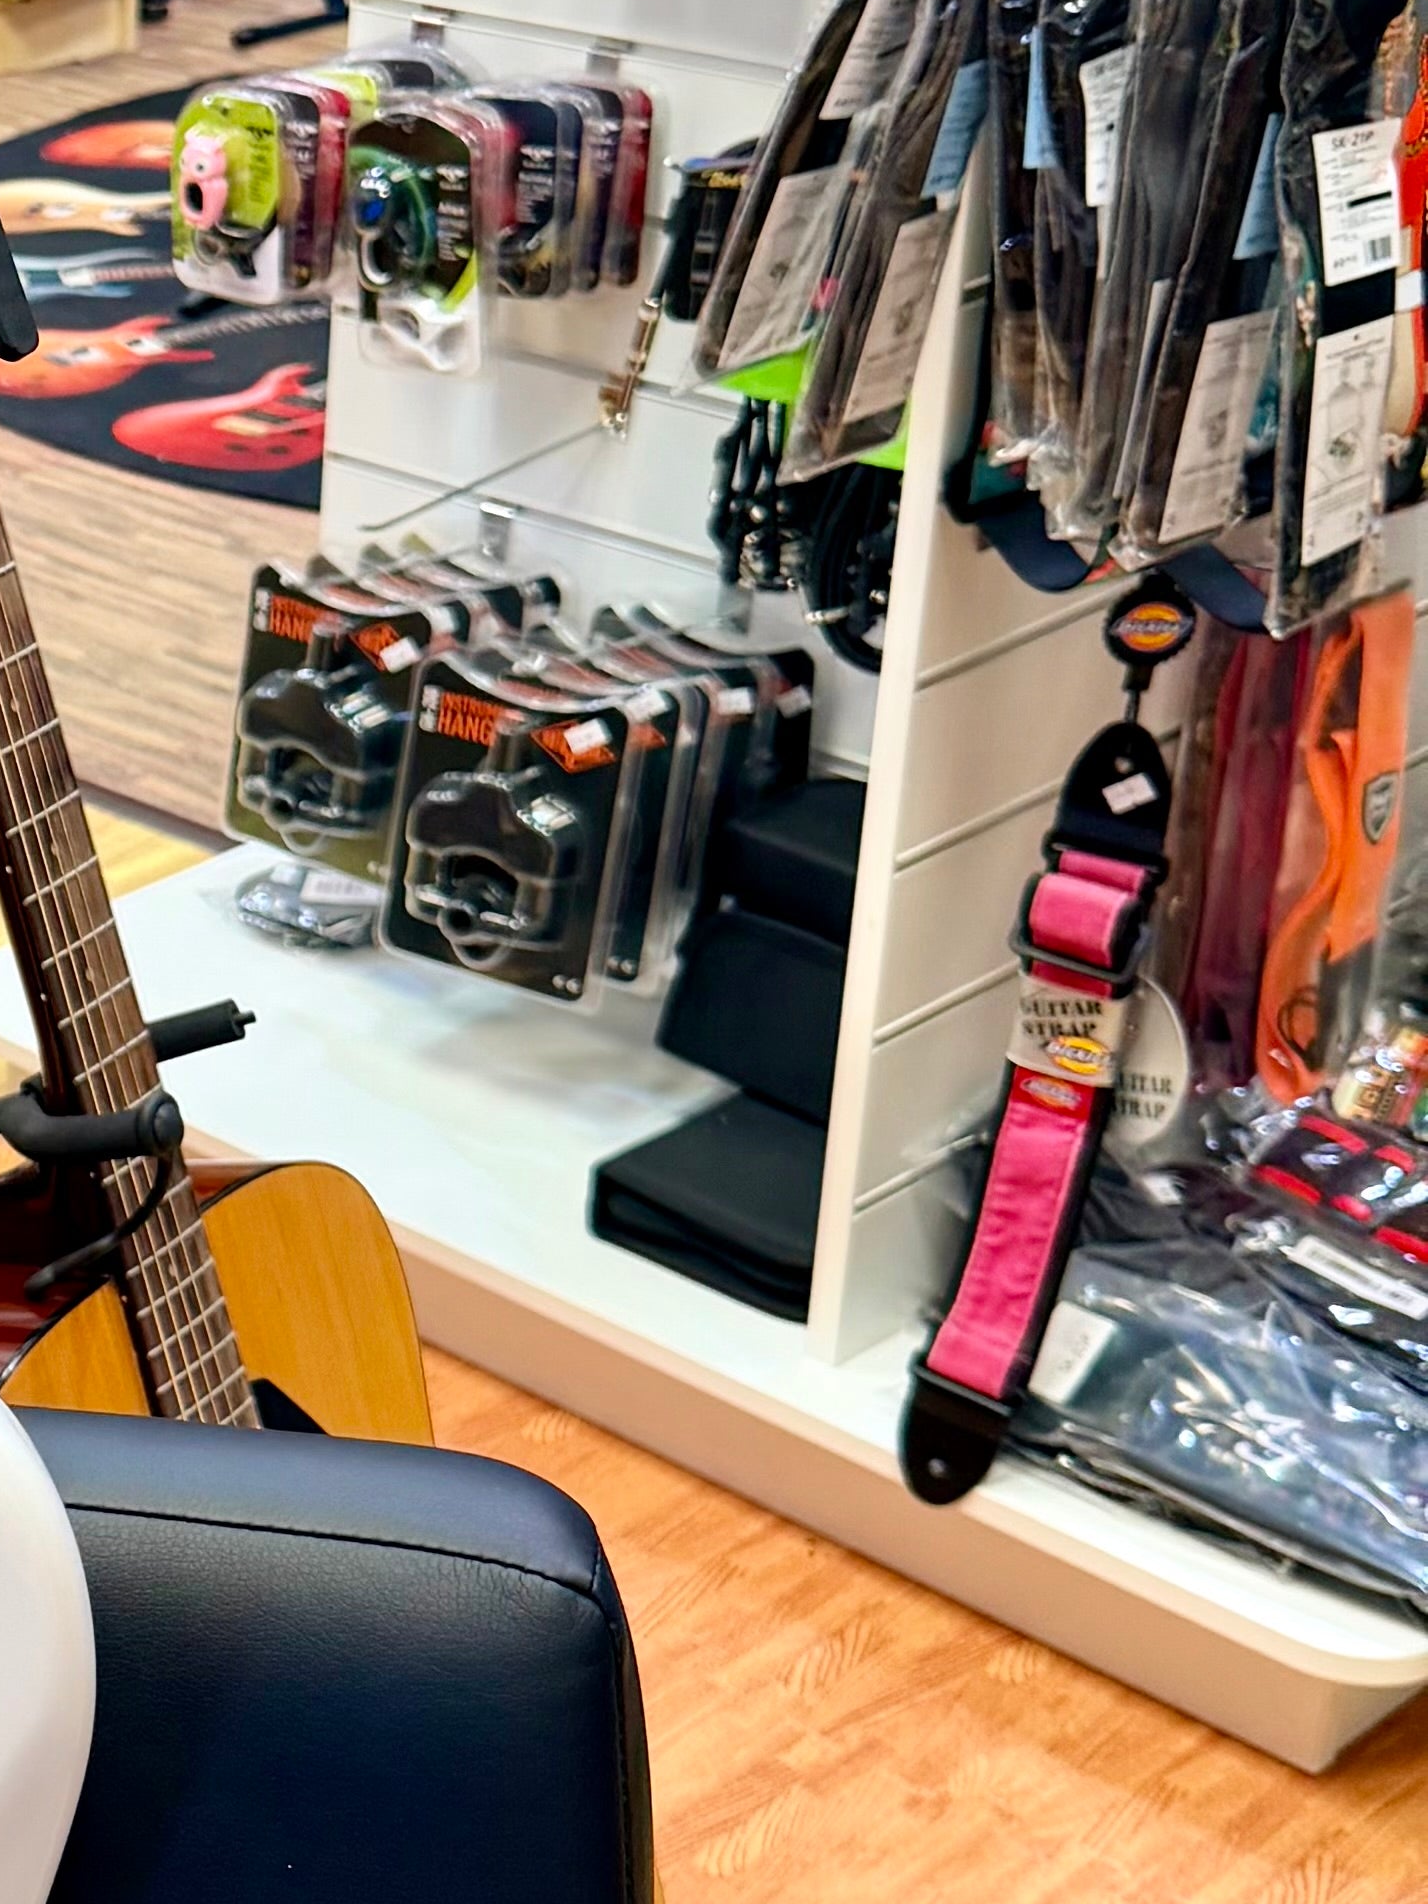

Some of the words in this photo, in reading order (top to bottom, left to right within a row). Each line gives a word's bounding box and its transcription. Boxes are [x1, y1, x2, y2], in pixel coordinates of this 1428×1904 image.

[1020, 997, 1103, 1017] GUITAR
[1022, 1019, 1097, 1038] STRAP
[1116, 1072, 1174, 1094] UITAR
